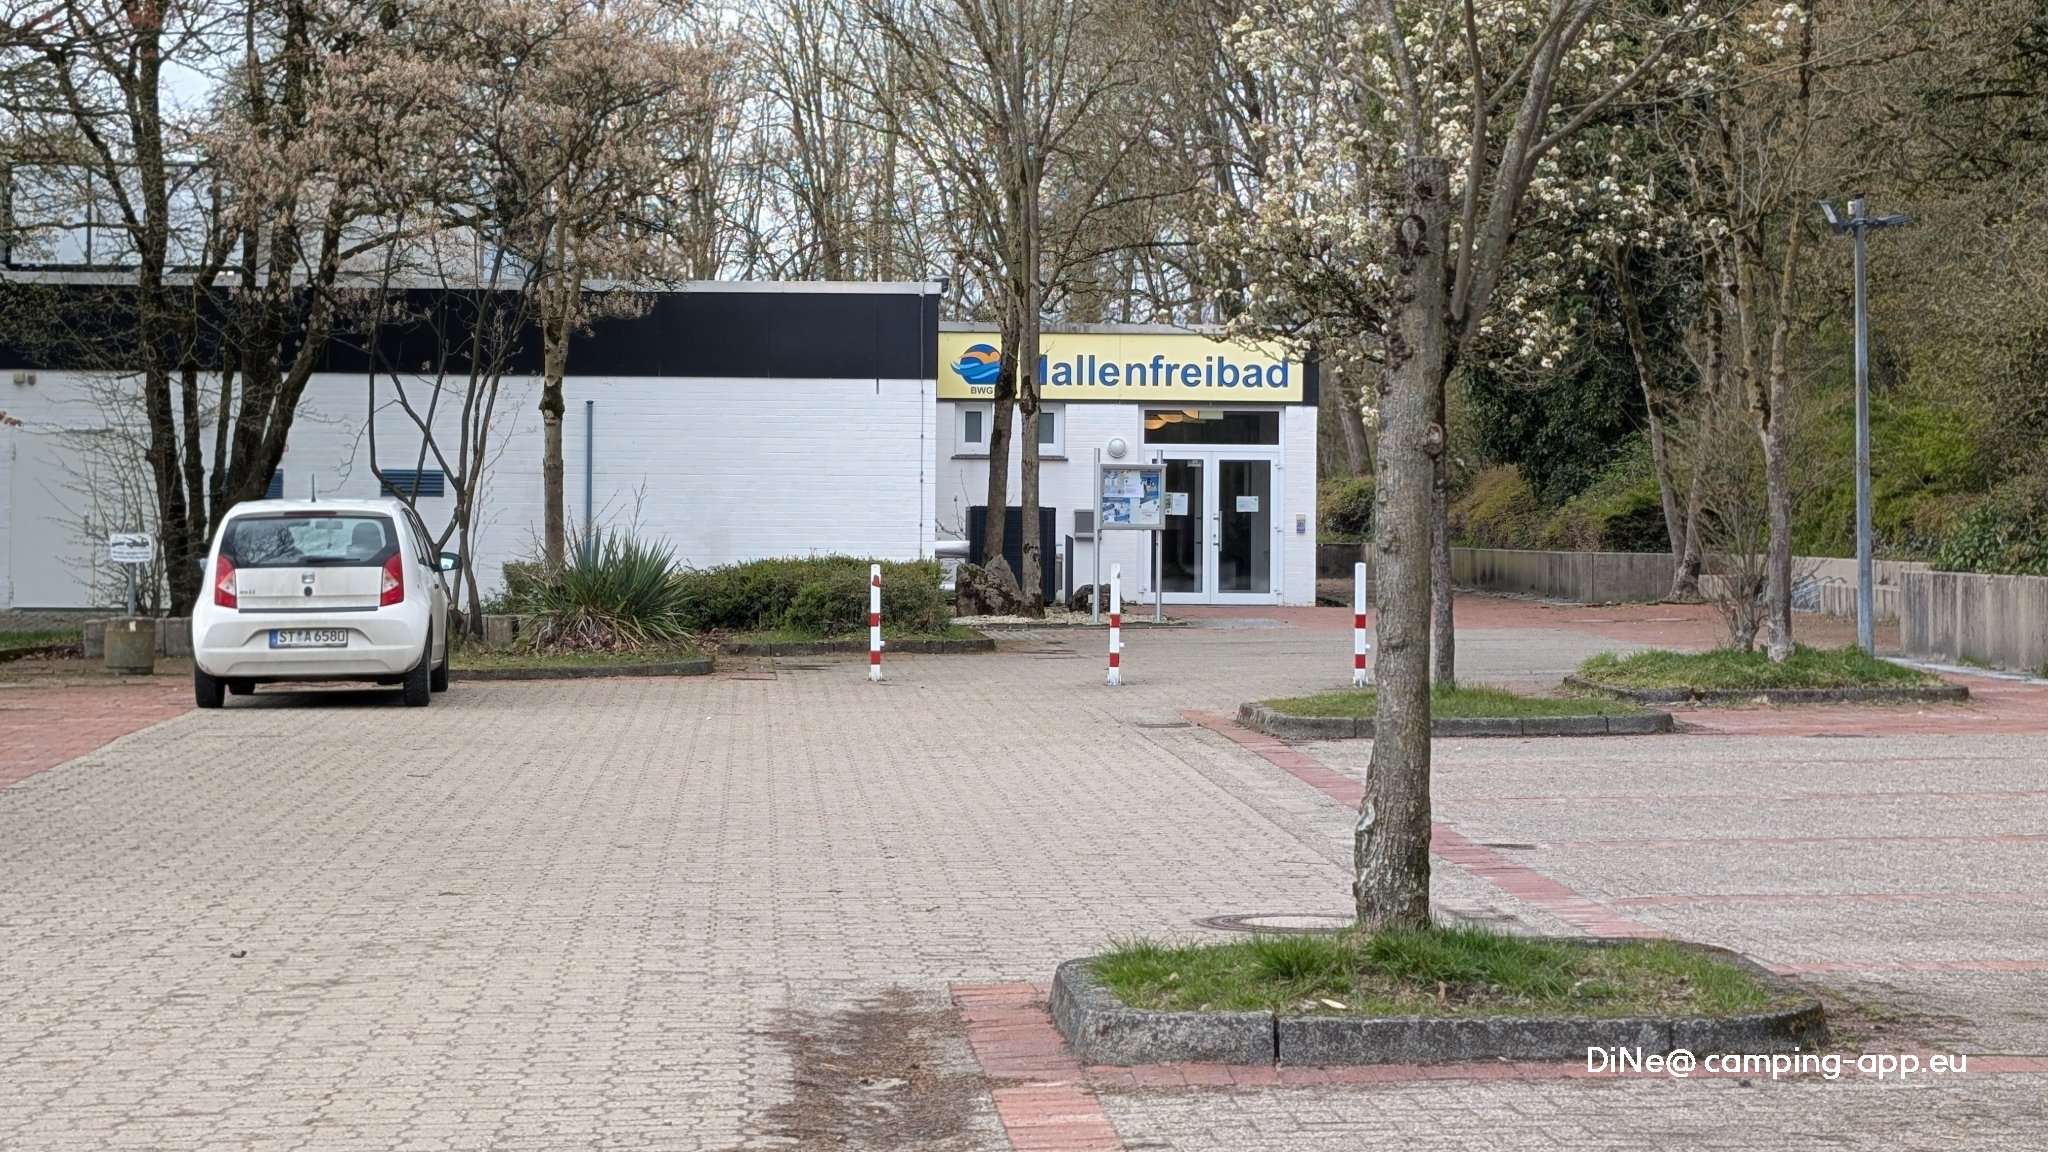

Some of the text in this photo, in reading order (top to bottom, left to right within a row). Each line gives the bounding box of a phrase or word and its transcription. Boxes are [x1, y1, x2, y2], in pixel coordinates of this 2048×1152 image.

[970, 386, 994, 395] BWG
[280, 630, 345, 643] ST A 6580
